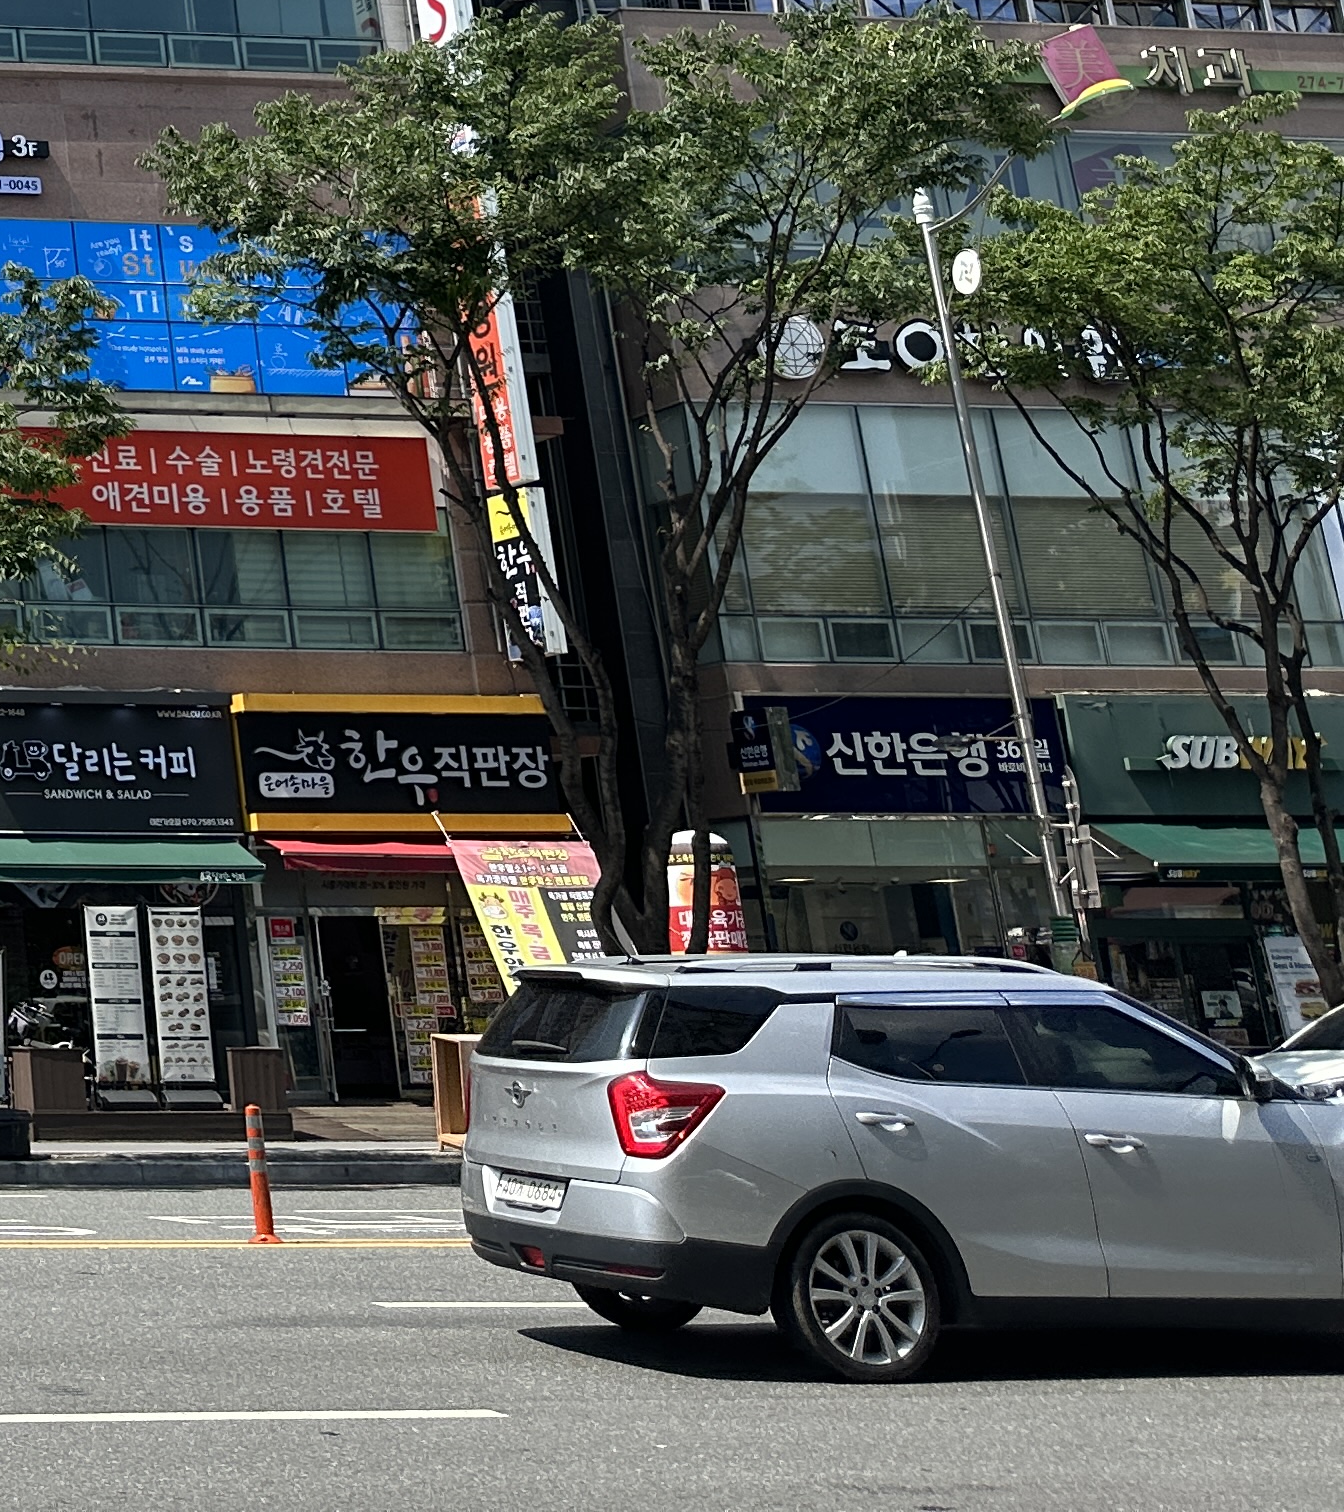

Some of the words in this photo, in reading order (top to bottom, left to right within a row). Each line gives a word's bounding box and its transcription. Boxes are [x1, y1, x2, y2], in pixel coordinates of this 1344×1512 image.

[1140, 45, 1255, 97] 치과
[12, 135, 39, 157] 3F
[165, 444, 222, 477] 수술
[245, 447, 379, 483] 노령견전문
[92, 483, 210, 517] 애견미용
[235, 485, 297, 518] 용품
[322, 488, 383, 520] 호텔
[826, 731, 990, 778] 신한은행
[43, 789, 103, 800] SANDWICH
[106, 789, 114, 800] &
[116, 790, 152, 800] SALAD
